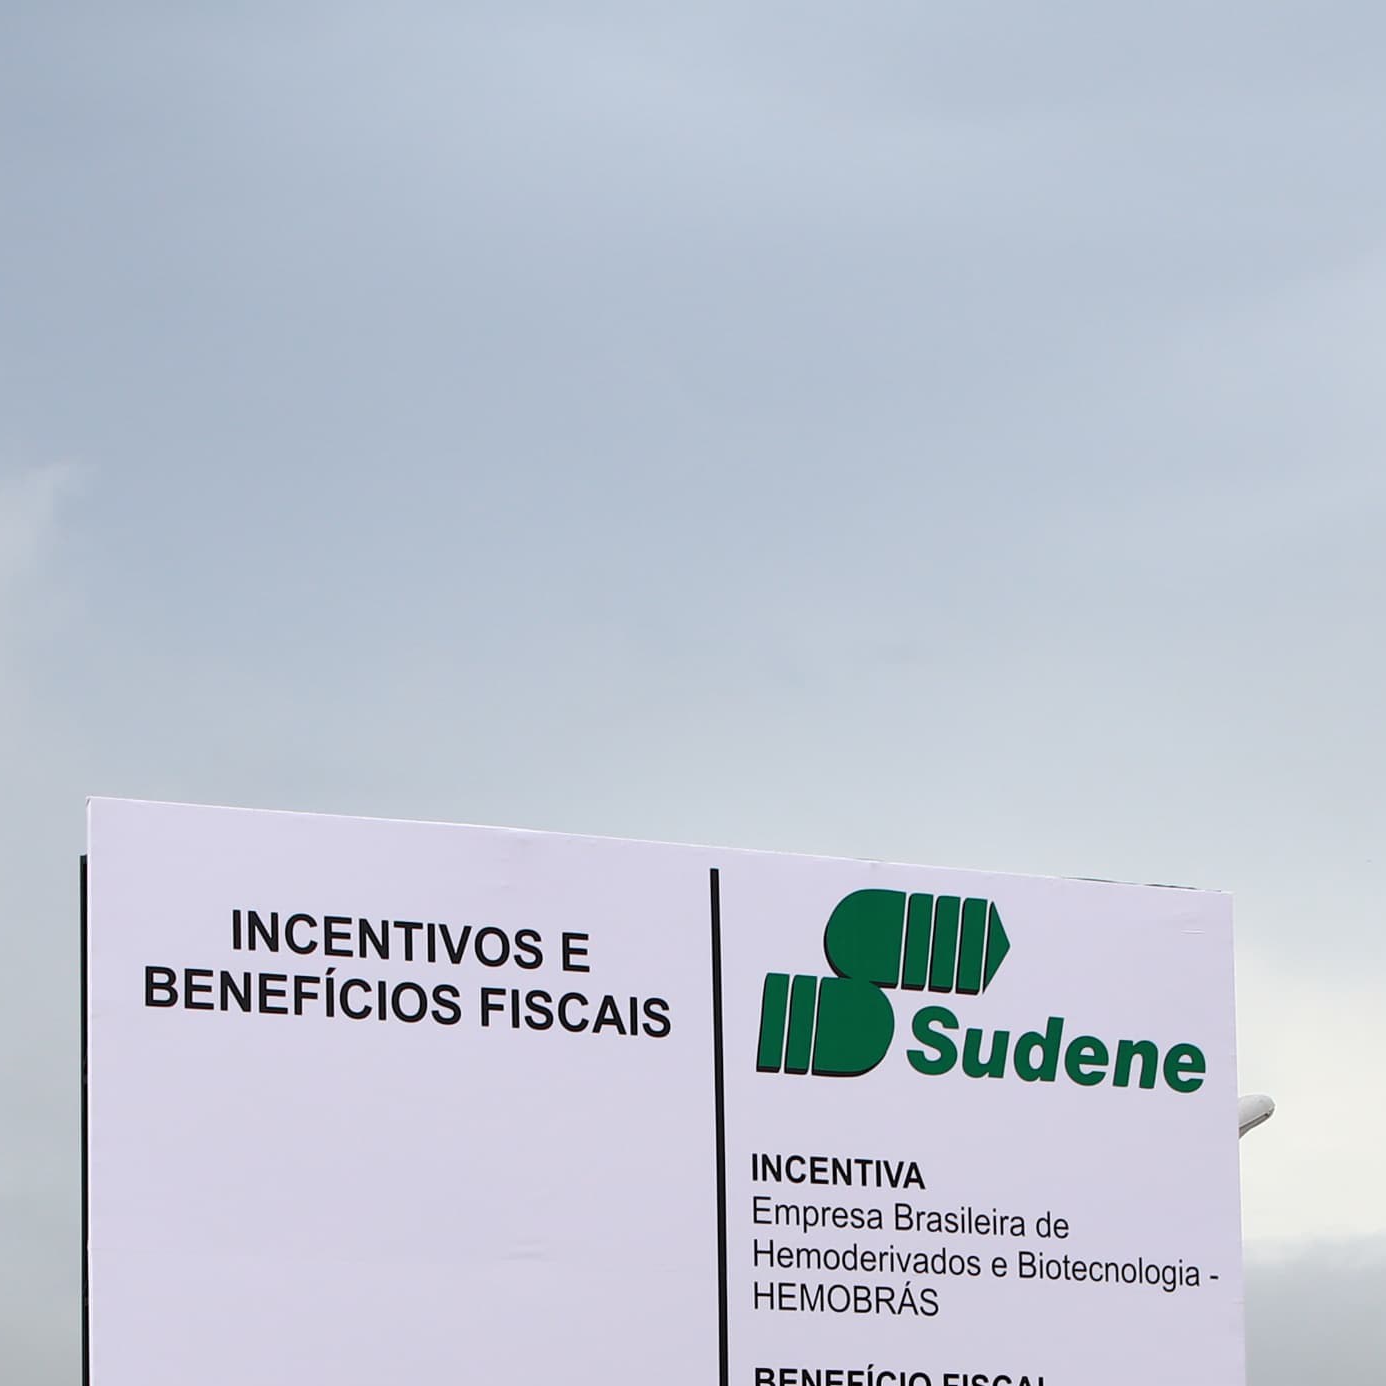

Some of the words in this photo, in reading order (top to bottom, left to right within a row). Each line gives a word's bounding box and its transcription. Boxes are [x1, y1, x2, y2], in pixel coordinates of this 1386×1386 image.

[232, 910, 544, 971] INCENTIVOS
[562, 932, 590, 972] E
[145, 966, 461, 1025] BENEFÍCIOS
[481, 987, 670, 1038] FISCAIS
[906, 1006, 1207, 1093] Sudene
[752, 1153, 925, 1189] INCENTIVA
[753, 1196, 882, 1233] Empresa
[895, 1203, 1025, 1236] Brasileira
[1036, 1211, 1069, 1239] de
[754, 1239, 981, 1276] Hemoderivados
[992, 1257, 1007, 1277] e
[1019, 1251, 1199, 1292] Biotecnologia
[754, 1281, 938, 1316] HEMOBRÁS
